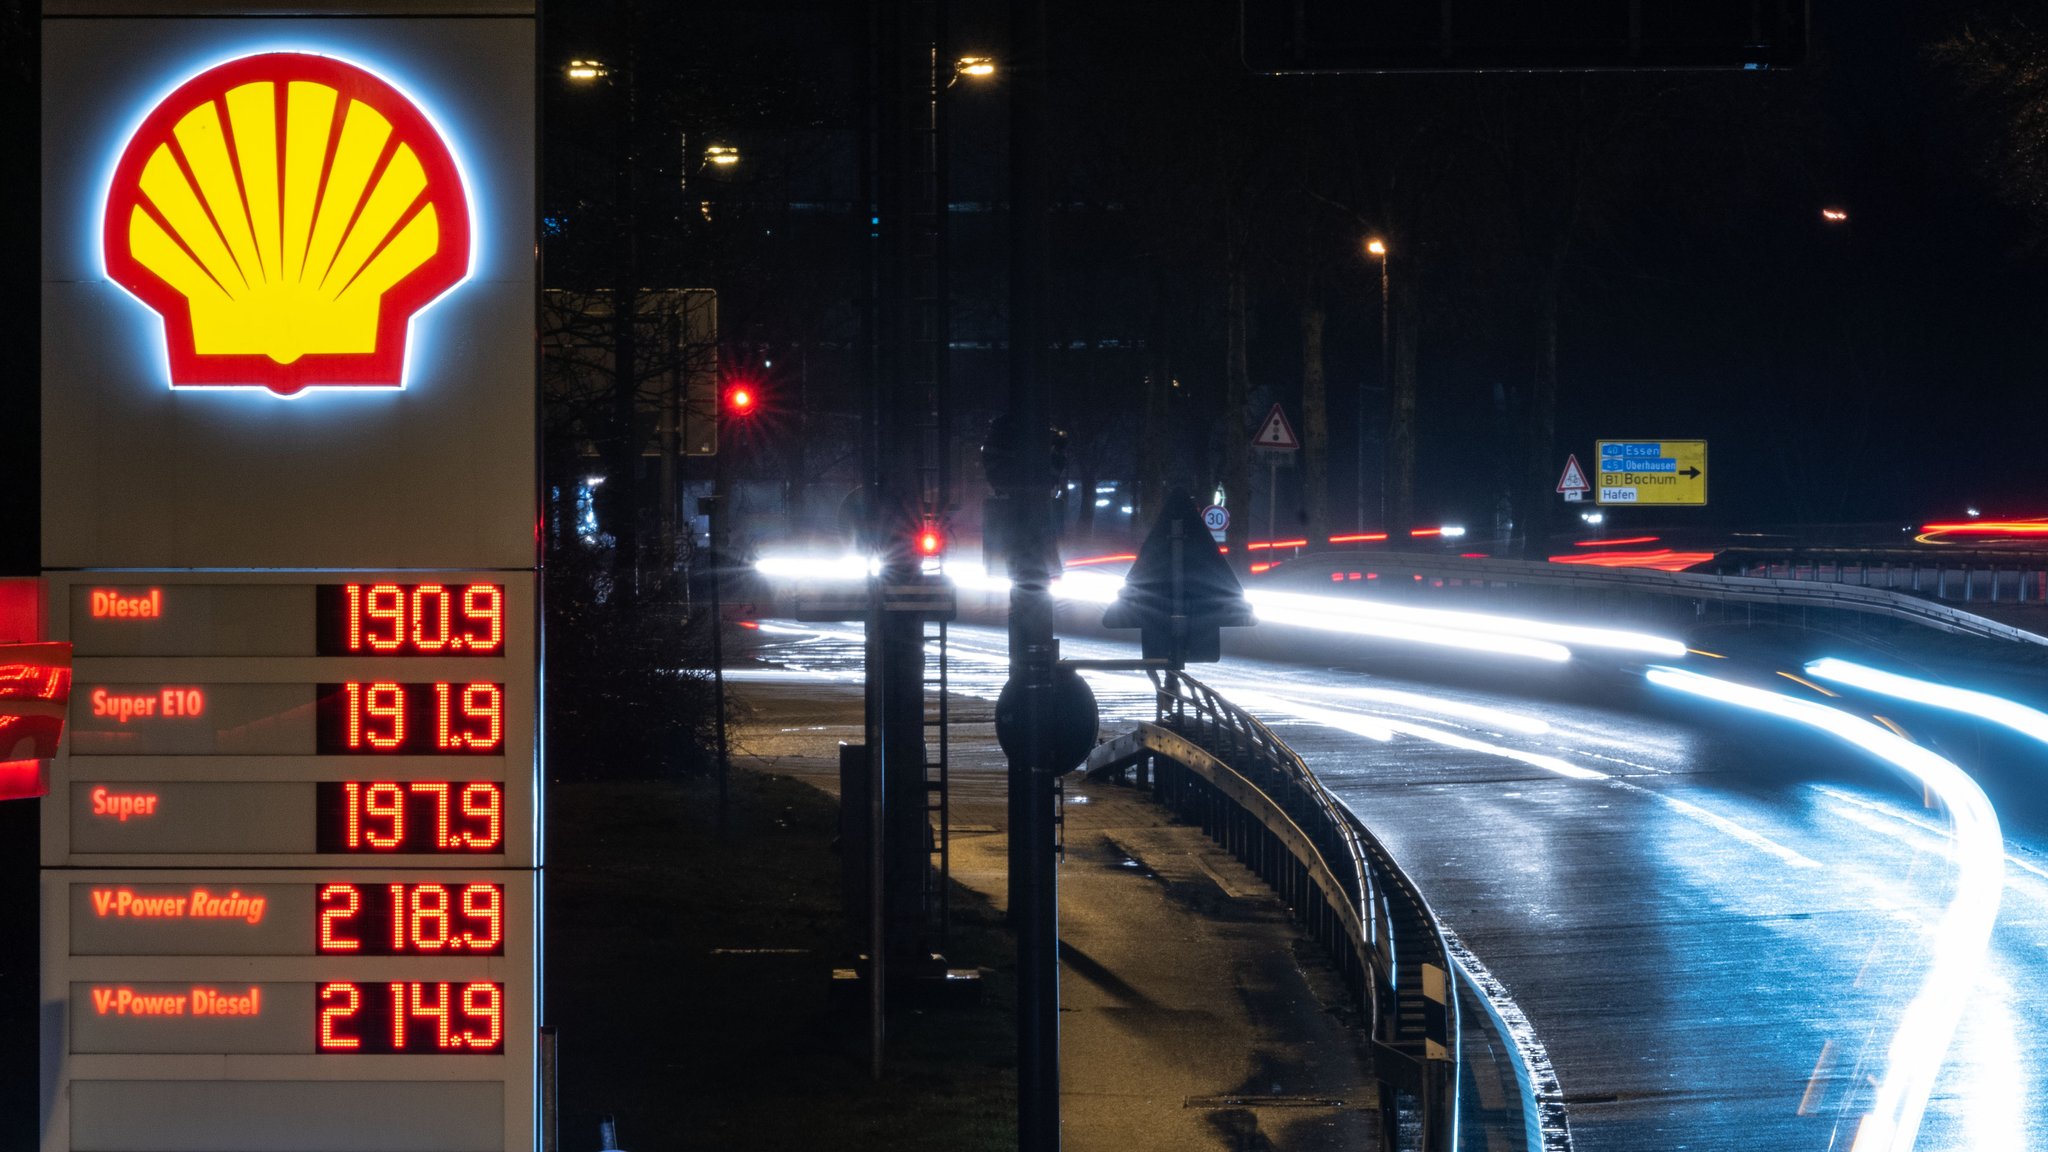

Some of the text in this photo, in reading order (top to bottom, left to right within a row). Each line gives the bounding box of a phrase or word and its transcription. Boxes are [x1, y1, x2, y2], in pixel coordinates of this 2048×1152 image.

[1626, 445, 1659, 455] Essen
[1605, 473, 1676, 485] B1 Bochum
[1625, 460, 1676, 470] Oberhausen
[1603, 489, 1635, 500] Hafen
[1207, 512, 1224, 525] 30
[92, 590, 160, 618] Diesel
[348, 585, 500, 648] 190.9
[92, 689, 202, 723] Super E10
[347, 683, 500, 747] 191.9
[92, 788, 157, 821] Super
[346, 784, 499, 847] 197.9
[92, 890, 266, 925] V-Power Racing
[92, 987, 260, 1016] V-Power Diesel
